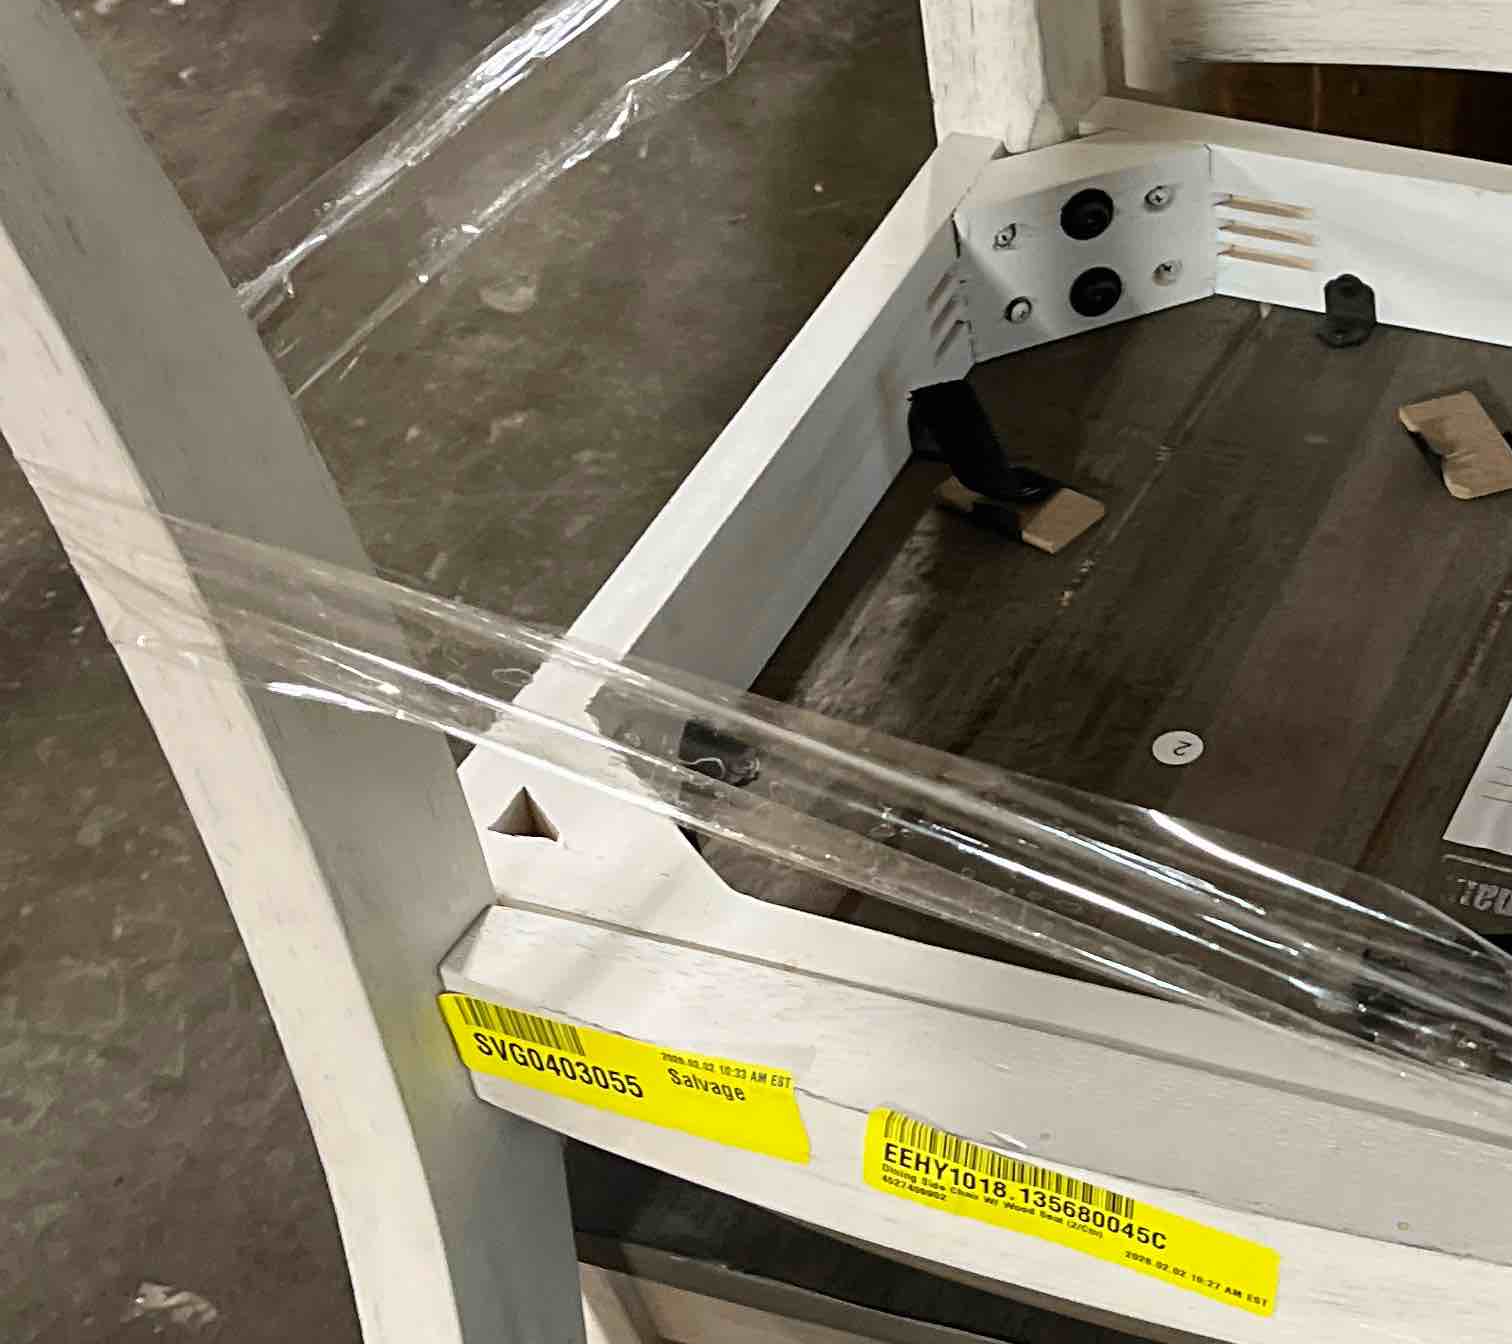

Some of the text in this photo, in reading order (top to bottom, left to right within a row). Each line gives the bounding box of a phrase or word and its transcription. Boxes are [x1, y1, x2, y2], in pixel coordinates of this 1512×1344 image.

[473, 1031, 644, 1098] SVG0403055
[750, 1071, 768, 1084] AM
[667, 1067, 747, 1102] Salvage
[1224, 1285, 1243, 1299] AM
[1246, 1293, 1268, 1308] EST
